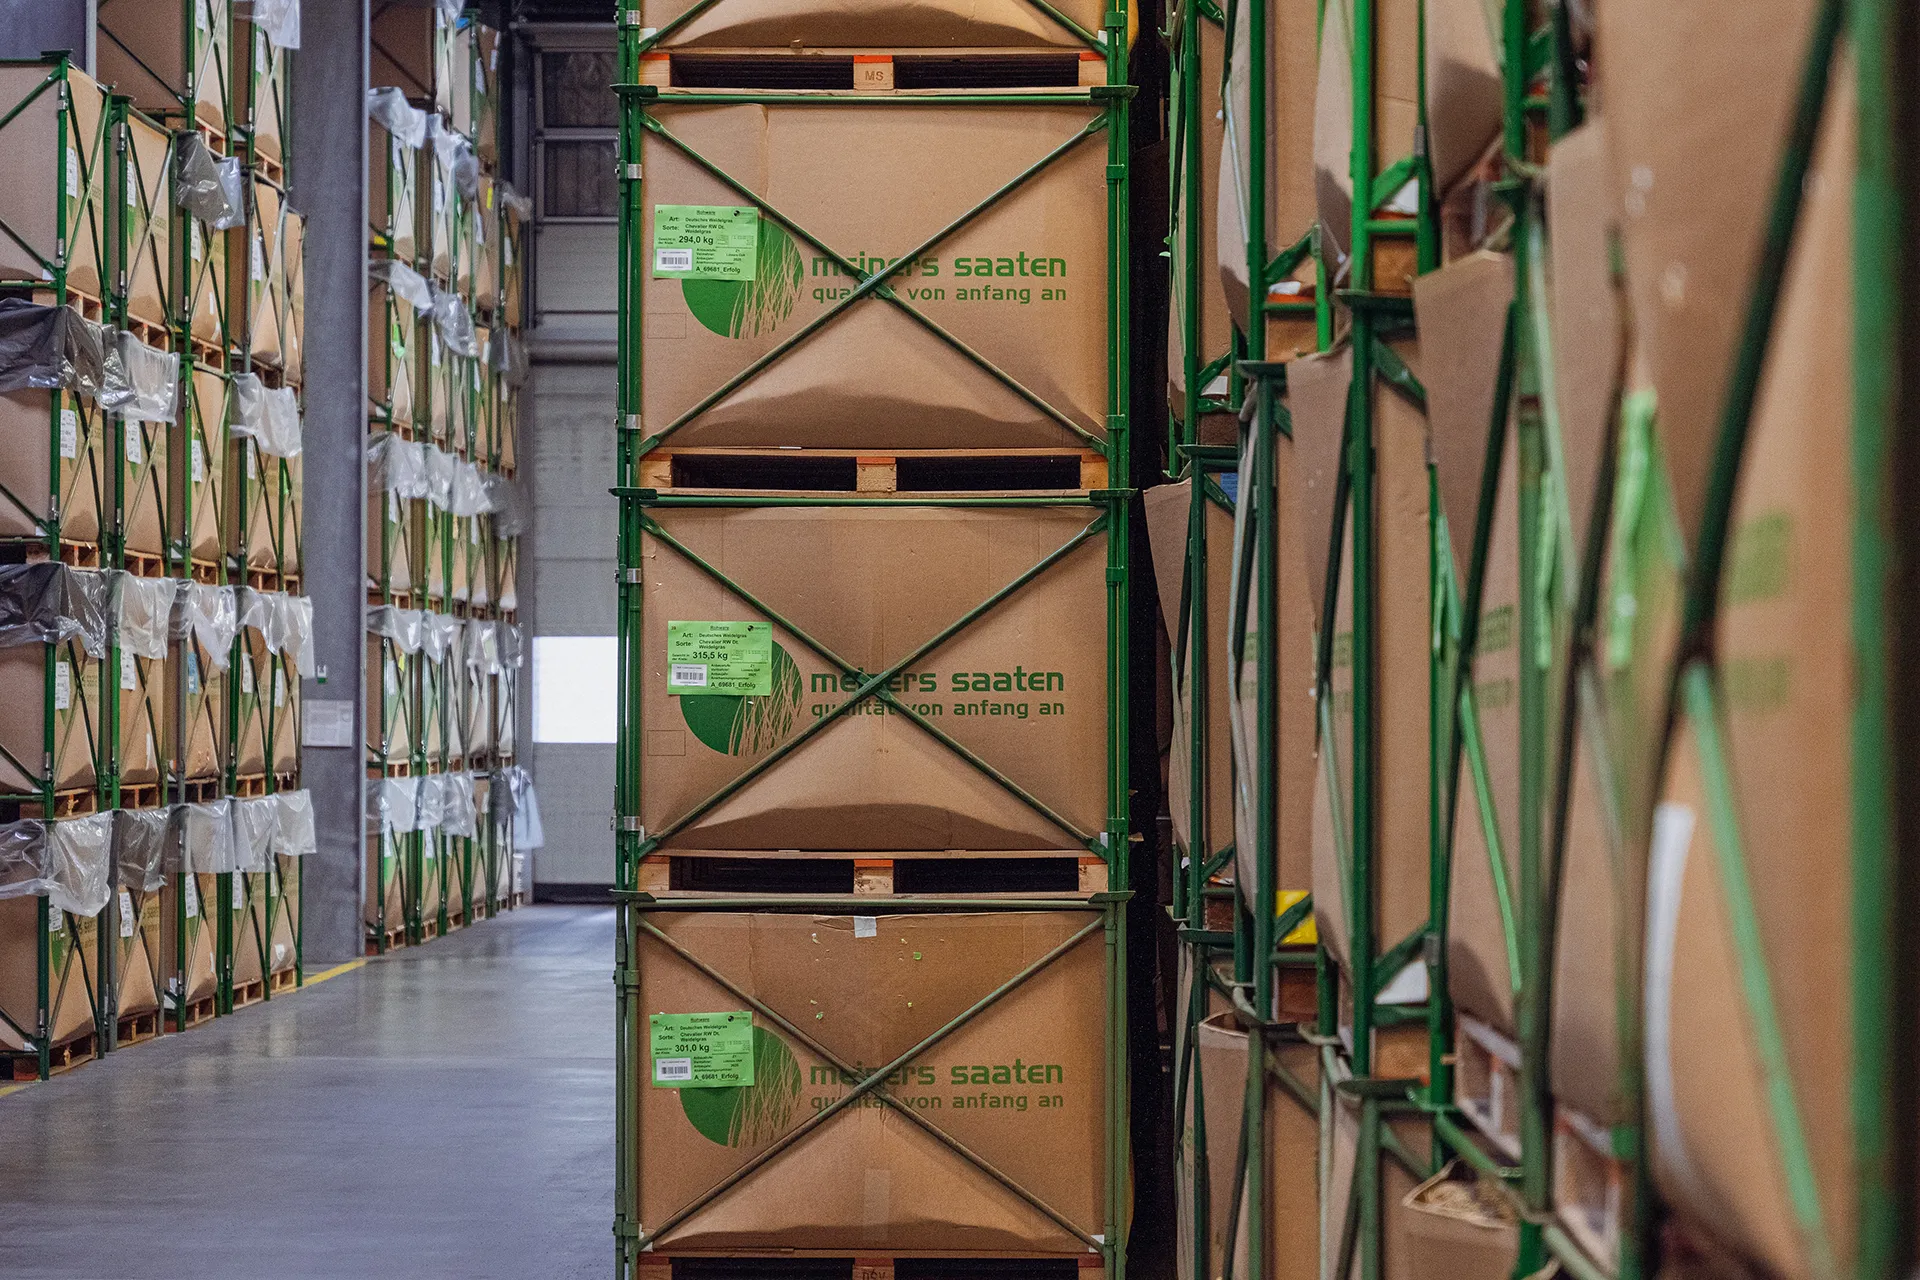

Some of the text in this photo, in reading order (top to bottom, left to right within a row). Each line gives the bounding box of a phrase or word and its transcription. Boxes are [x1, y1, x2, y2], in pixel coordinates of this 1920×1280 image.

[864, 70, 884, 81] MS
[679, 236, 700, 244] 294,0
[703, 236, 713, 245] kg
[954, 252, 1066, 277] saaten
[907, 288, 945, 300] von
[956, 284, 1031, 304] anfang
[1041, 288, 1066, 300] an
[693, 652, 715, 660] 315,5
[717, 652, 728, 661] kg
[811, 666, 1064, 692] meers saaten
[954, 700, 1028, 718] anfang
[1039, 702, 1064, 715] an
[675, 1044, 697, 1052] 301,0
[699, 1044, 710, 1053] kg
[951, 1058, 1063, 1085] saaten
[902, 1097, 941, 1109] von
[952, 1093, 1028, 1111] anfang
[1039, 1094, 1063, 1108] an
